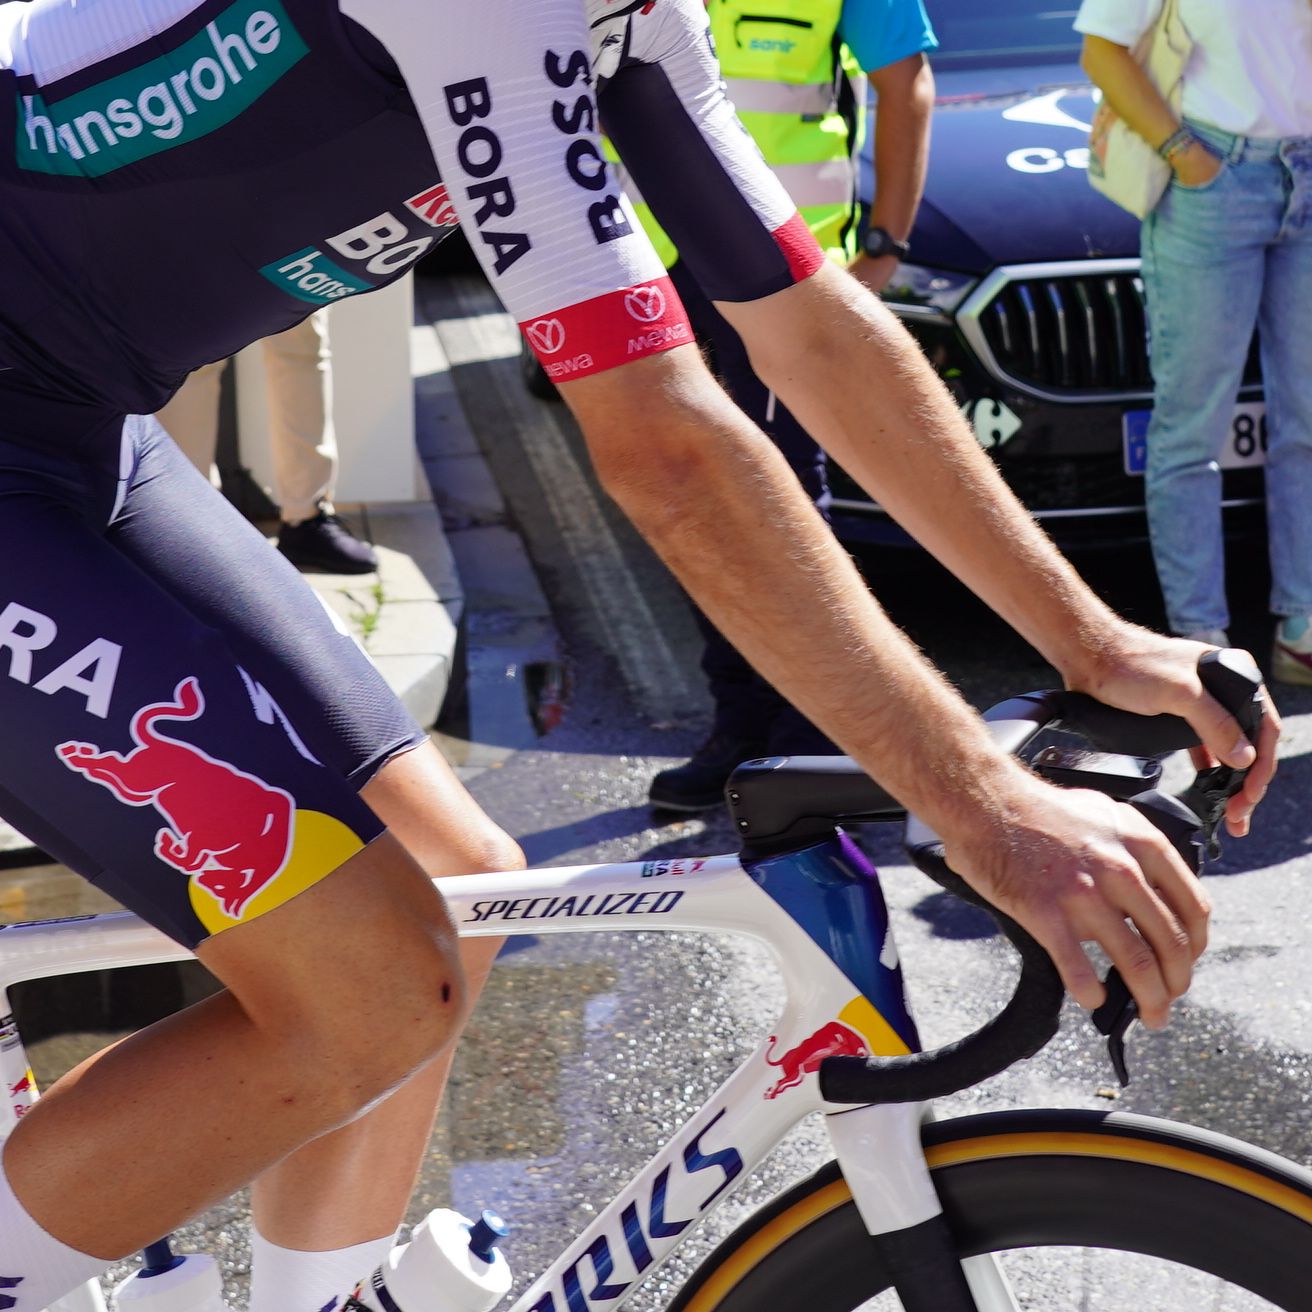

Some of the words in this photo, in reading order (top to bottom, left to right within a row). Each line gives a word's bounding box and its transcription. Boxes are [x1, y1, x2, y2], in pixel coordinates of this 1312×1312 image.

[444, 76, 532, 276] BORA
[545, 49, 634, 244] BOSS
[463, 890, 686, 923] SPECIALIZED
